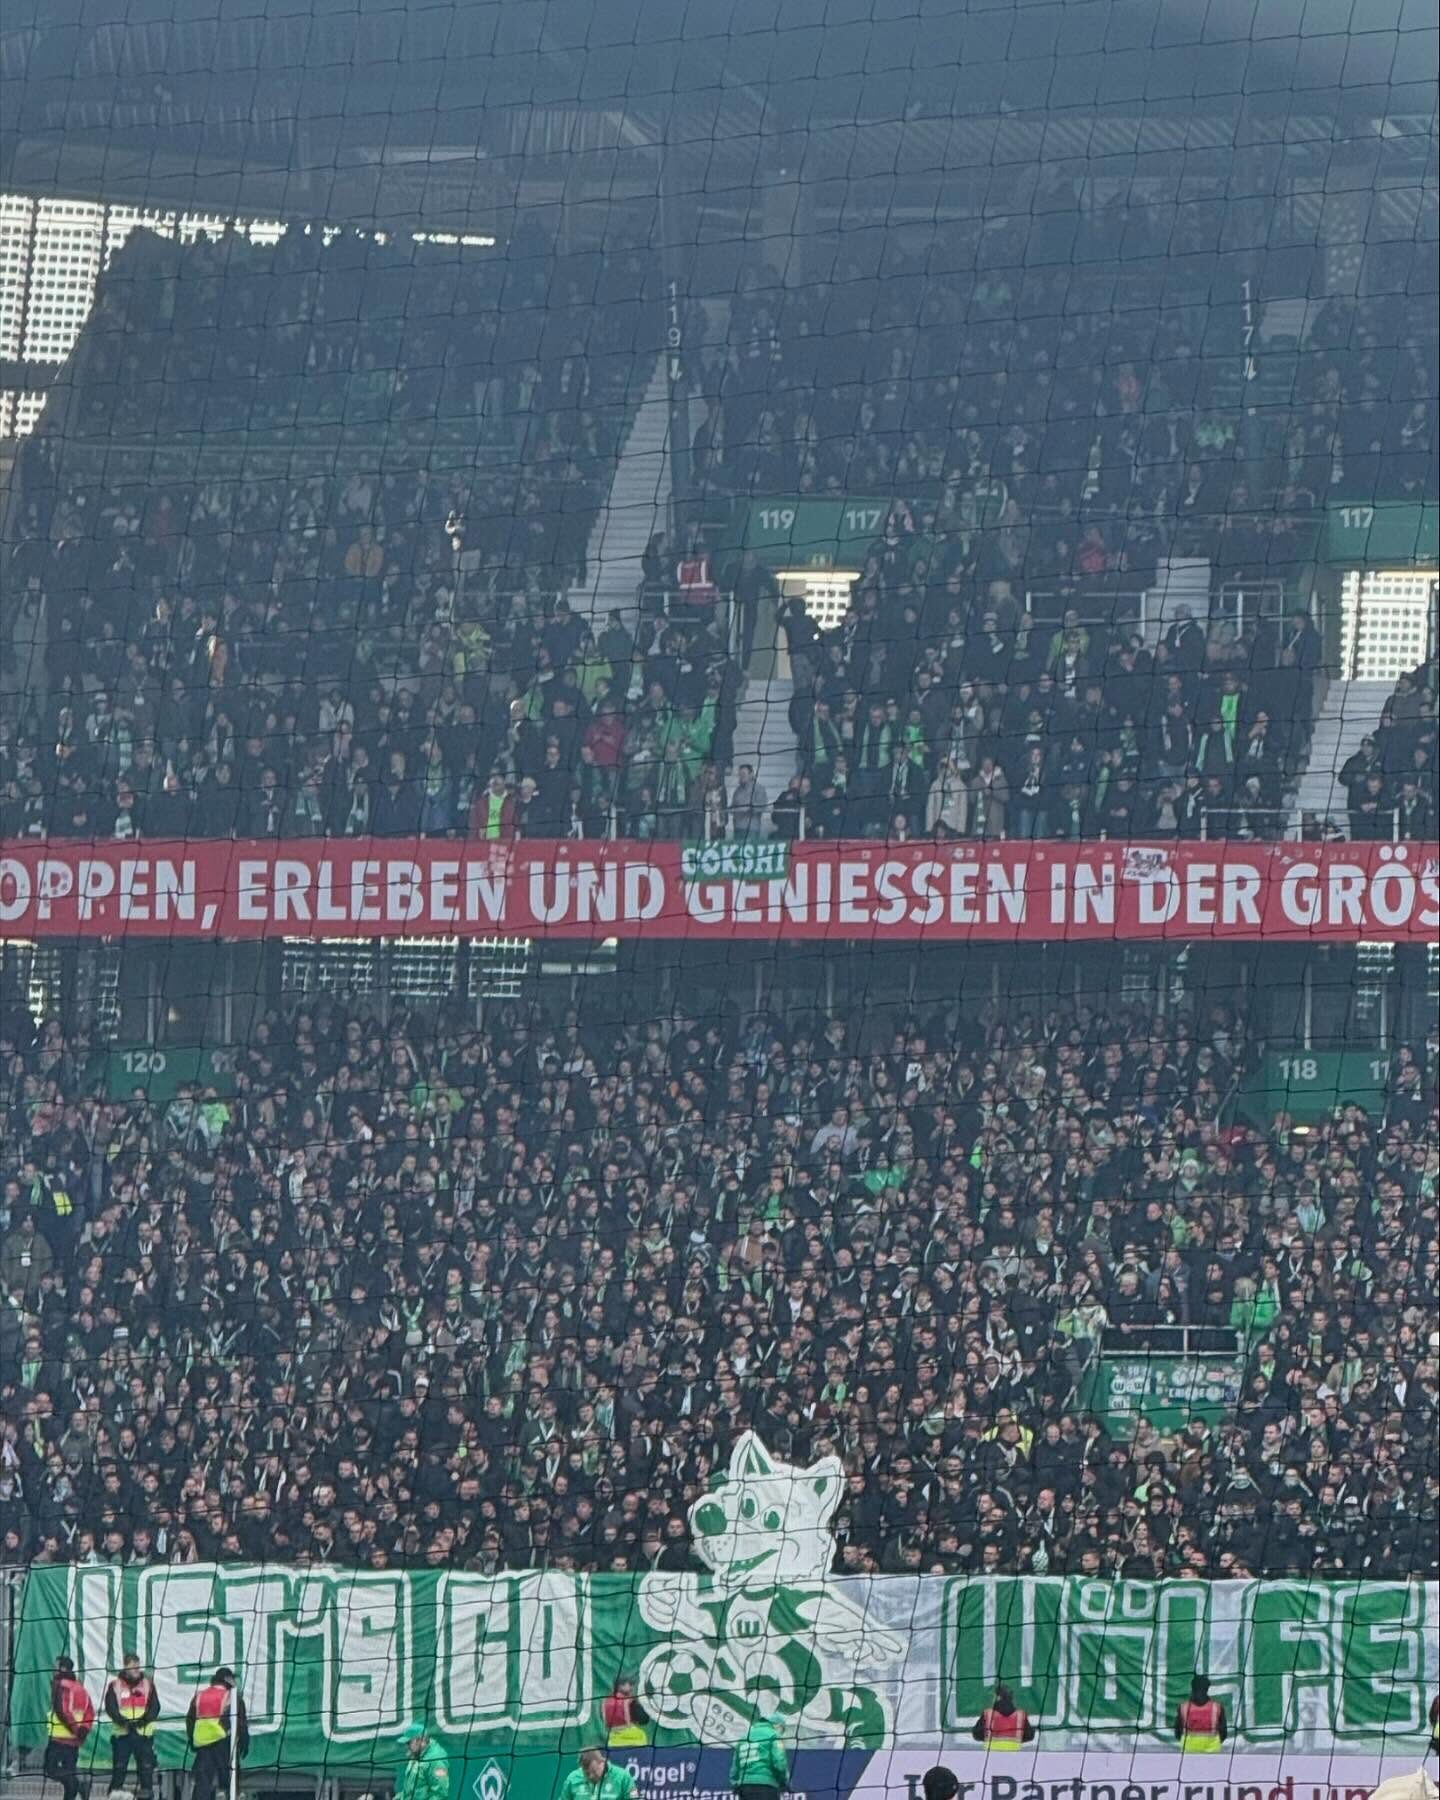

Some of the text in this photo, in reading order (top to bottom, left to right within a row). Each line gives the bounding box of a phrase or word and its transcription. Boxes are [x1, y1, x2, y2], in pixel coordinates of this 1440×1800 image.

[668, 282, 681, 346] 119
[1241, 280, 1254, 345] 117
[760, 510, 795, 529] 119
[846, 510, 881, 530] 117
[1339, 507, 1374, 528] 117
[238, 861, 503, 921] ERLEBEN
[530, 861, 665, 922] UND
[684, 862, 1027, 924] GENIESSEN
[1050, 863, 1115, 923] IN
[1138, 863, 1260, 924] DER
[122, 1052, 166, 1073] 120
[1279, 1059, 1317, 1080] 118
[1369, 1060, 1391, 1081] 11
[941, 1576, 1425, 1742] WÖLFE
